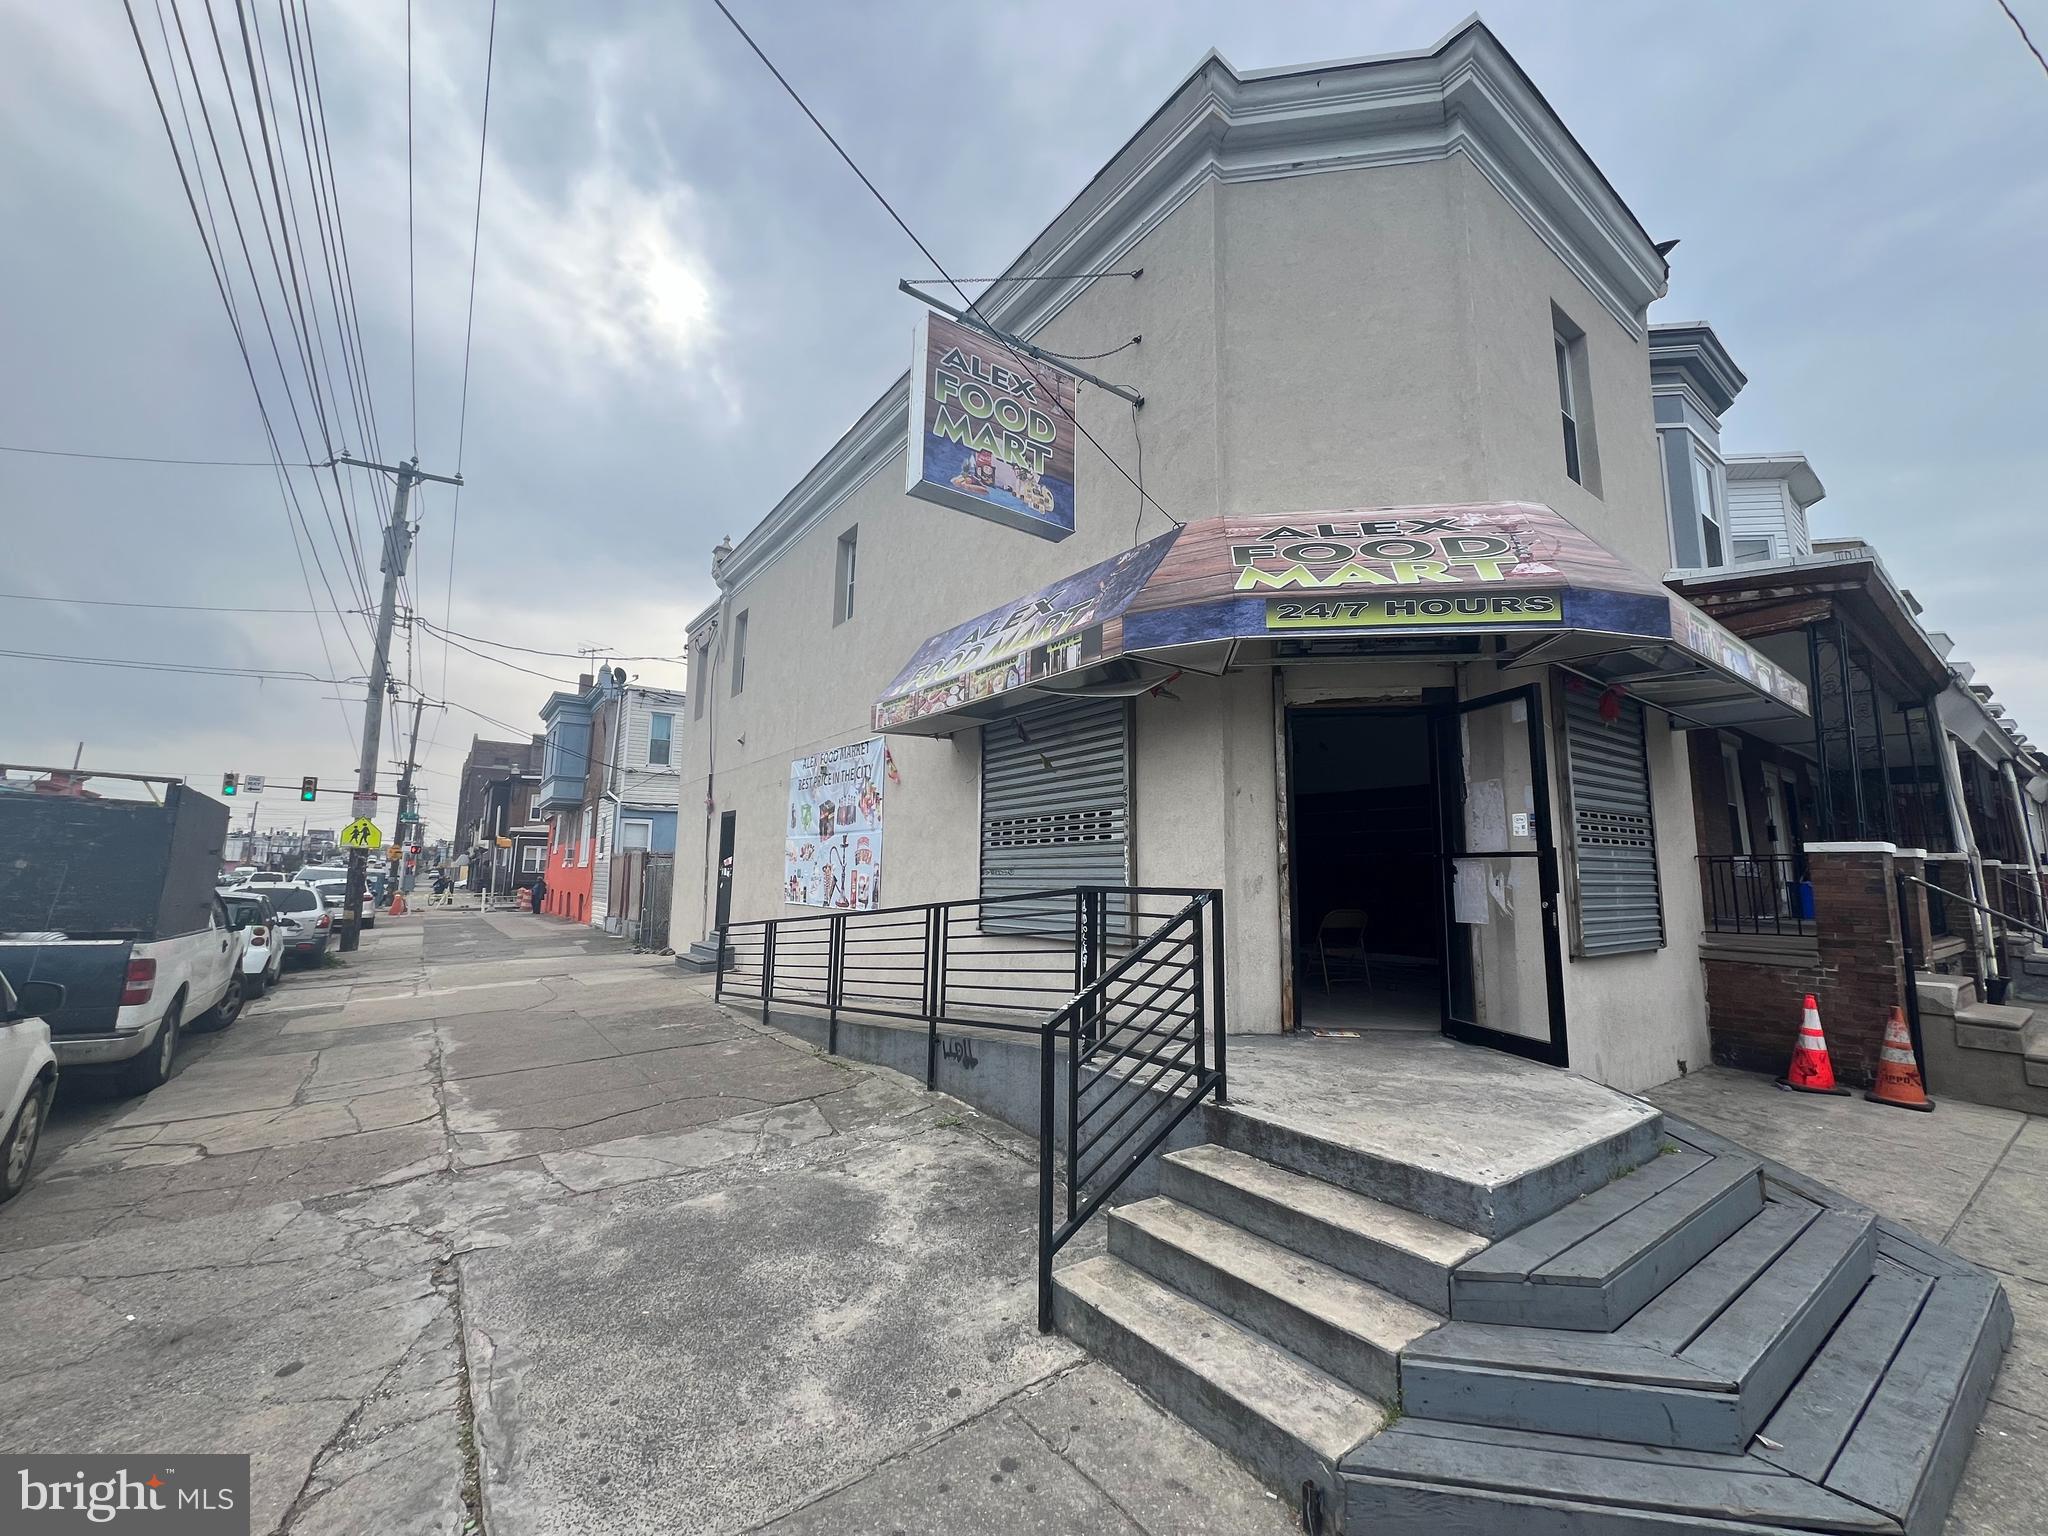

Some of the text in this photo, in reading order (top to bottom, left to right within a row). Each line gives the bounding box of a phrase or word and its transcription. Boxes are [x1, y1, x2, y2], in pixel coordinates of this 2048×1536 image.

[940, 347, 1038, 405] ALEX
[934, 368, 1057, 444] FOOD
[933, 405, 1053, 475] MART
[1259, 517, 1468, 542] ALEX
[1231, 534, 1510, 567] FOOD
[1233, 556, 1519, 590] MART
[956, 589, 1066, 649] ALEX
[1275, 595, 1555, 621] 24/7 HOURS
[907, 597, 1095, 690] FOOD MART
[974, 656, 1018, 676] CLEANING
[802, 741, 870, 770] ALEX FOOD MARKET
[798, 763, 874, 791] BEST PRICE IN THE CITY
